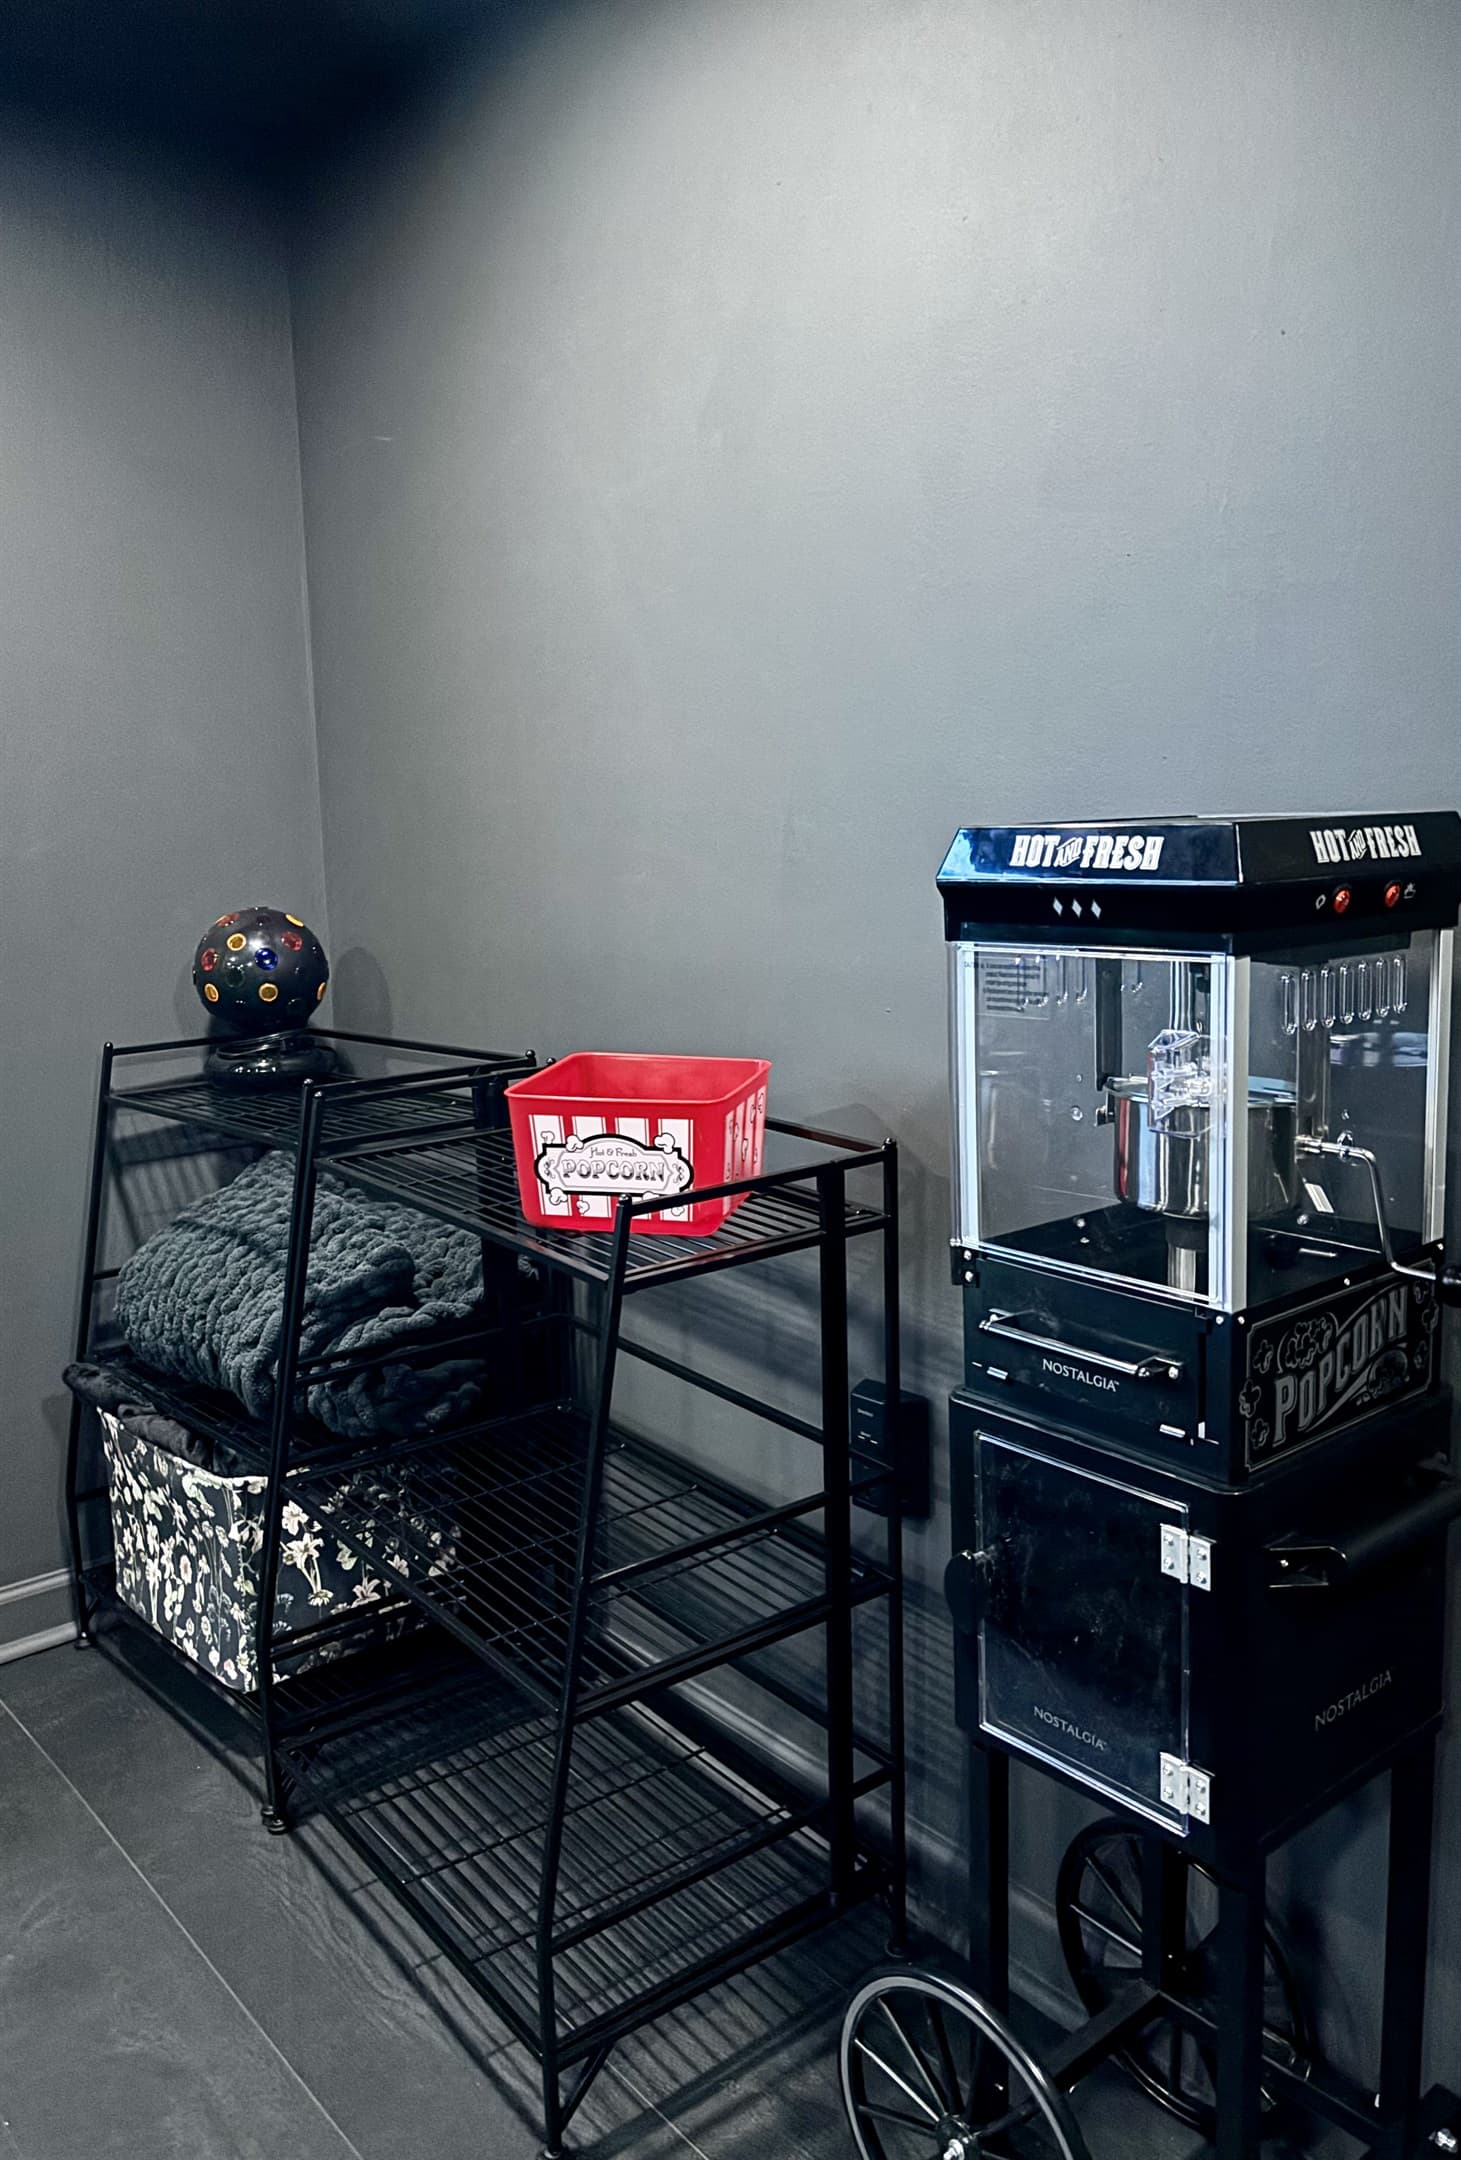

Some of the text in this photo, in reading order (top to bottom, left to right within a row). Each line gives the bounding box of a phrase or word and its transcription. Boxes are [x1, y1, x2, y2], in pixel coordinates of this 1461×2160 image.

[1009, 834, 1165, 871] HOT AND FRESH
[1309, 828, 1351, 864] HOT
[1362, 824, 1422, 859] FRESH
[562, 1158, 665, 1182] POPCORN
[589, 1146, 638, 1158] Hot & Fresh
[1042, 1358, 1118, 1393] NOSTALGIA
[1272, 1284, 1409, 1449] POPCORN
[1313, 1668, 1393, 1733] NOSTALGIA
[1033, 1705, 1106, 1751] NOSTALGIA
